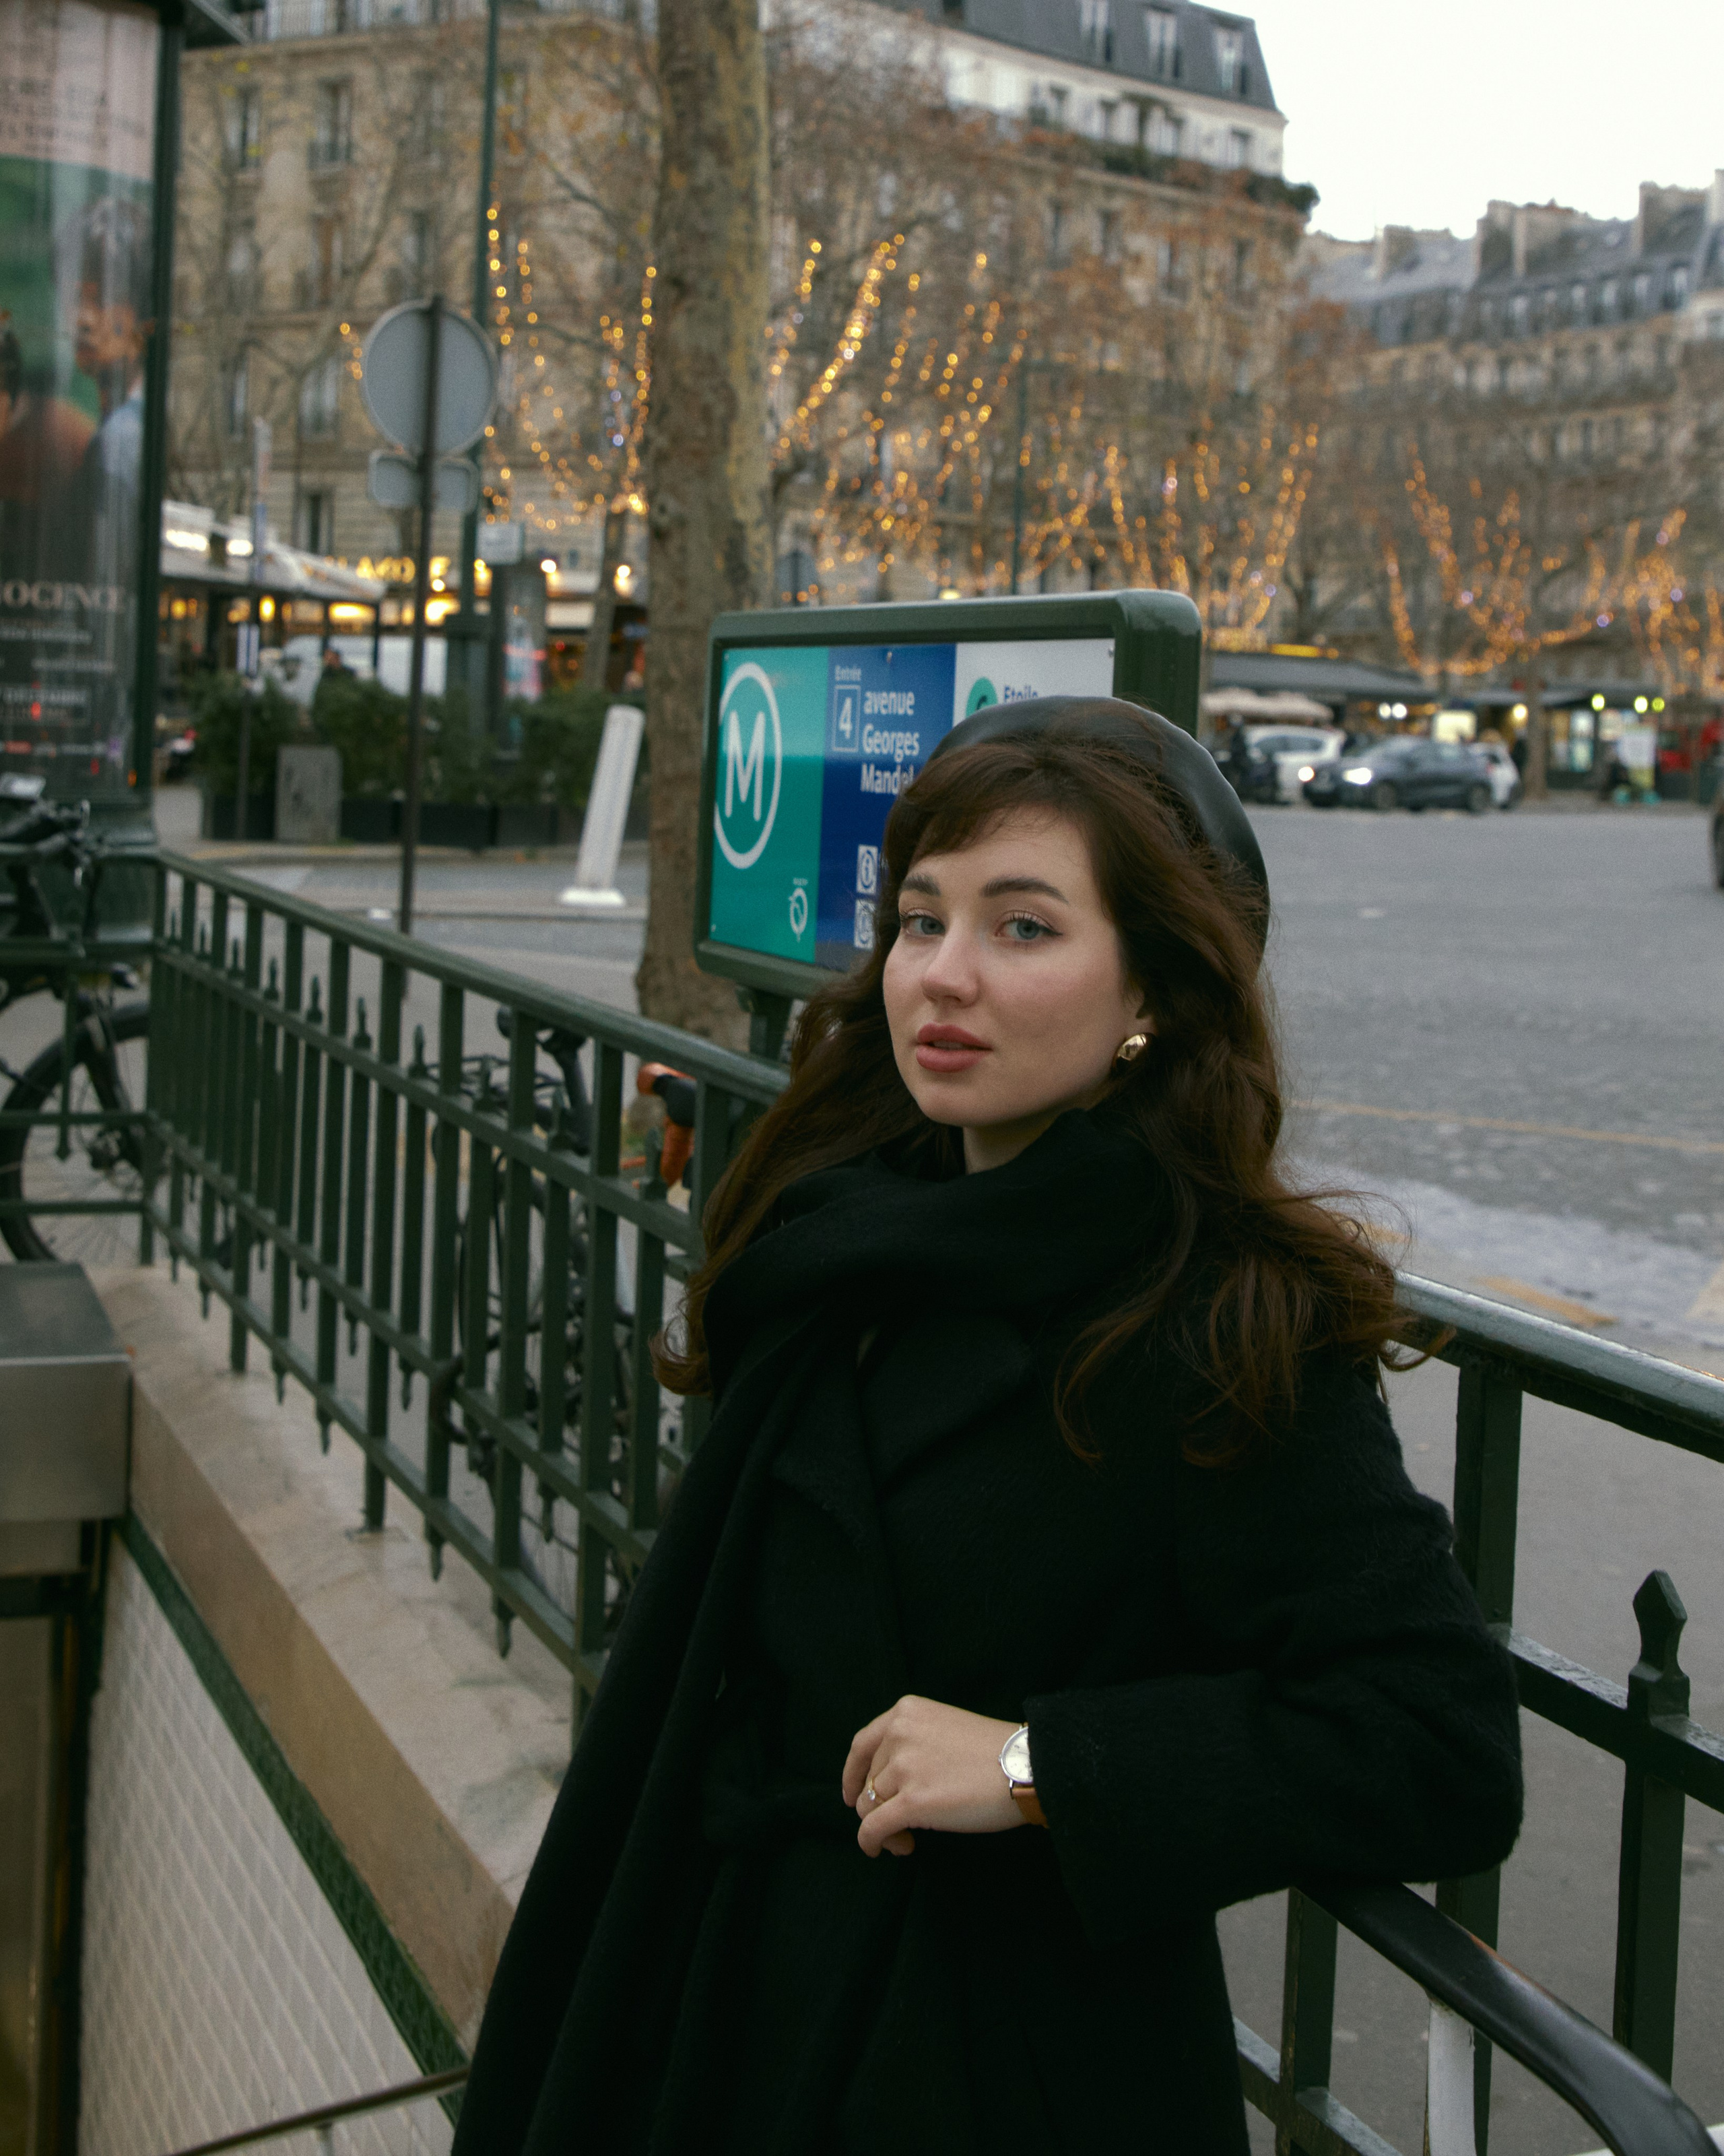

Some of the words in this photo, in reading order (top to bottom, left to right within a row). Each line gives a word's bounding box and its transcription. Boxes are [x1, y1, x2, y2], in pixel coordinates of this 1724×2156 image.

[838, 696, 852, 739] 4
[864, 692, 915, 715] avenue
[863, 724, 920, 763] Georges
[725, 710, 766, 822] M
